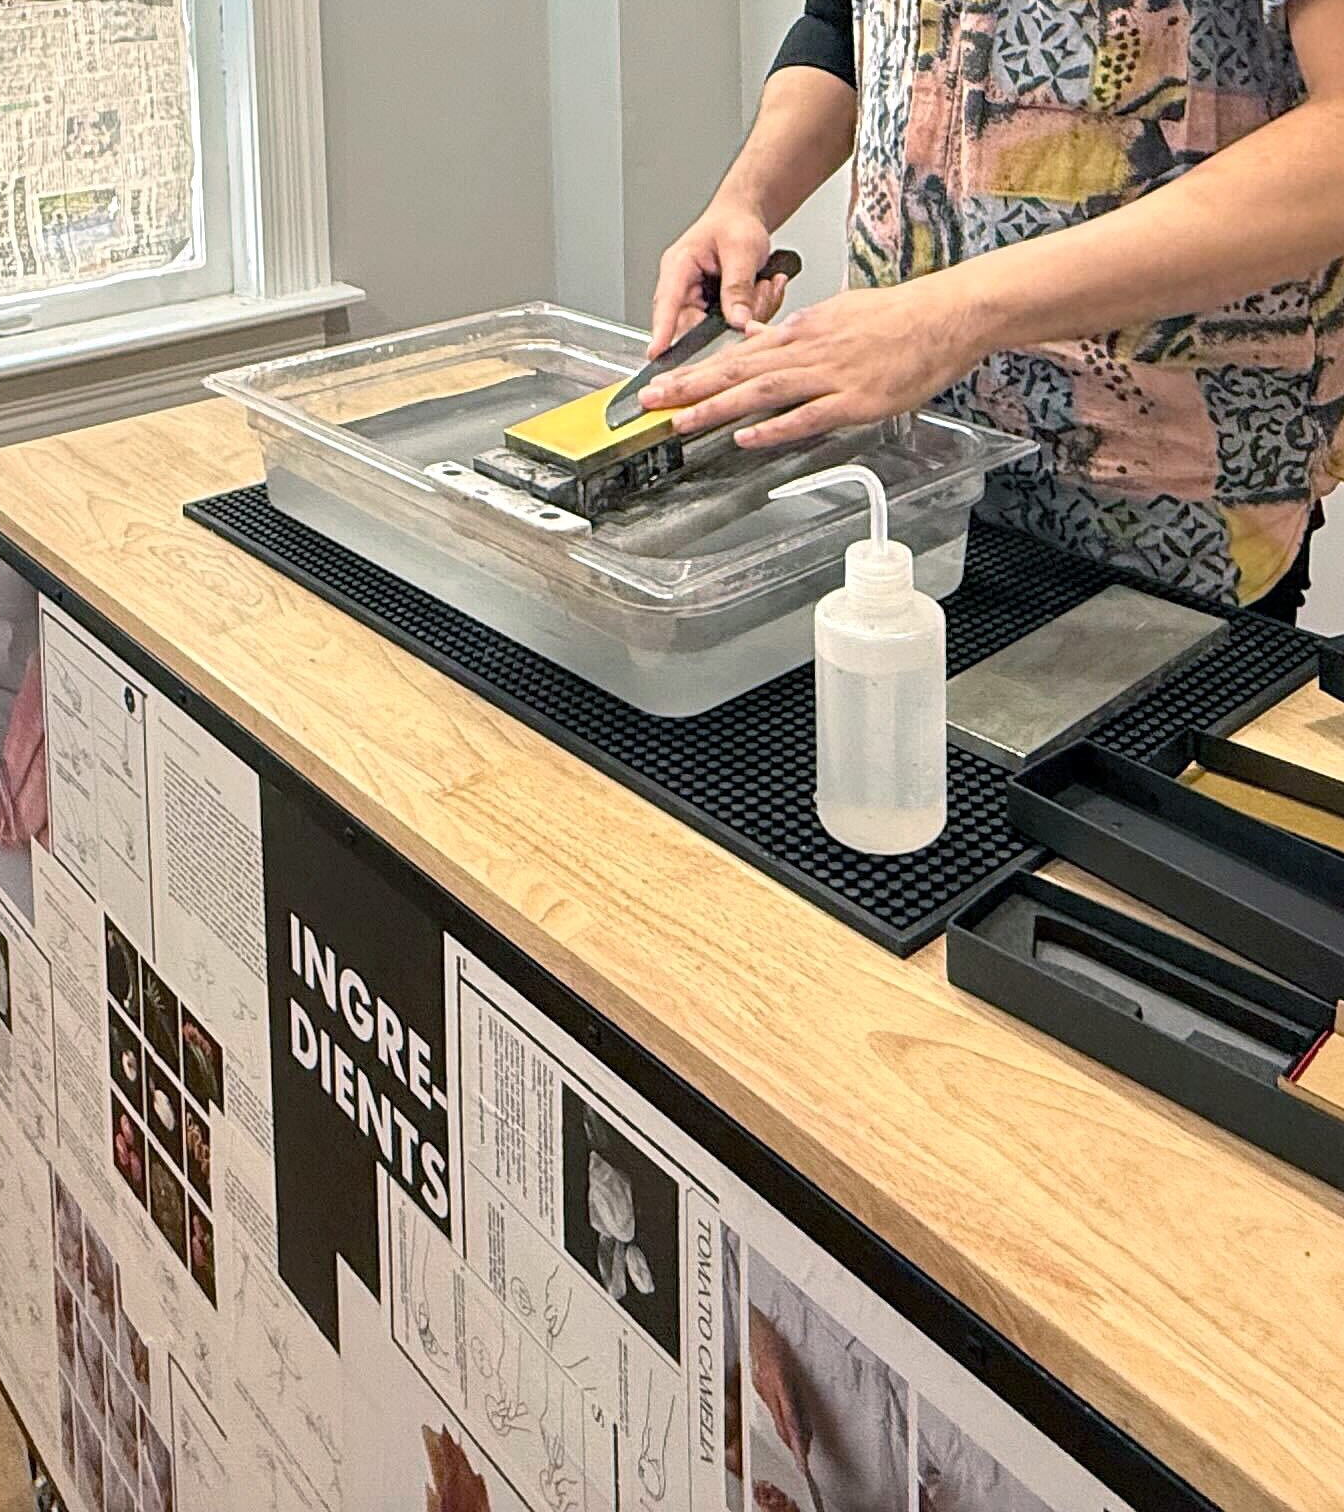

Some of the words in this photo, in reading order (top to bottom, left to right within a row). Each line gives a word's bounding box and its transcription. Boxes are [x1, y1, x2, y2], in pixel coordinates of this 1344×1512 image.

[290, 911, 447, 1111] INGRE-
[290, 997, 448, 1220] DIENTS
[697, 1219, 713, 1341] TOMATO
[698, 1345, 715, 1464] CAMELIA
